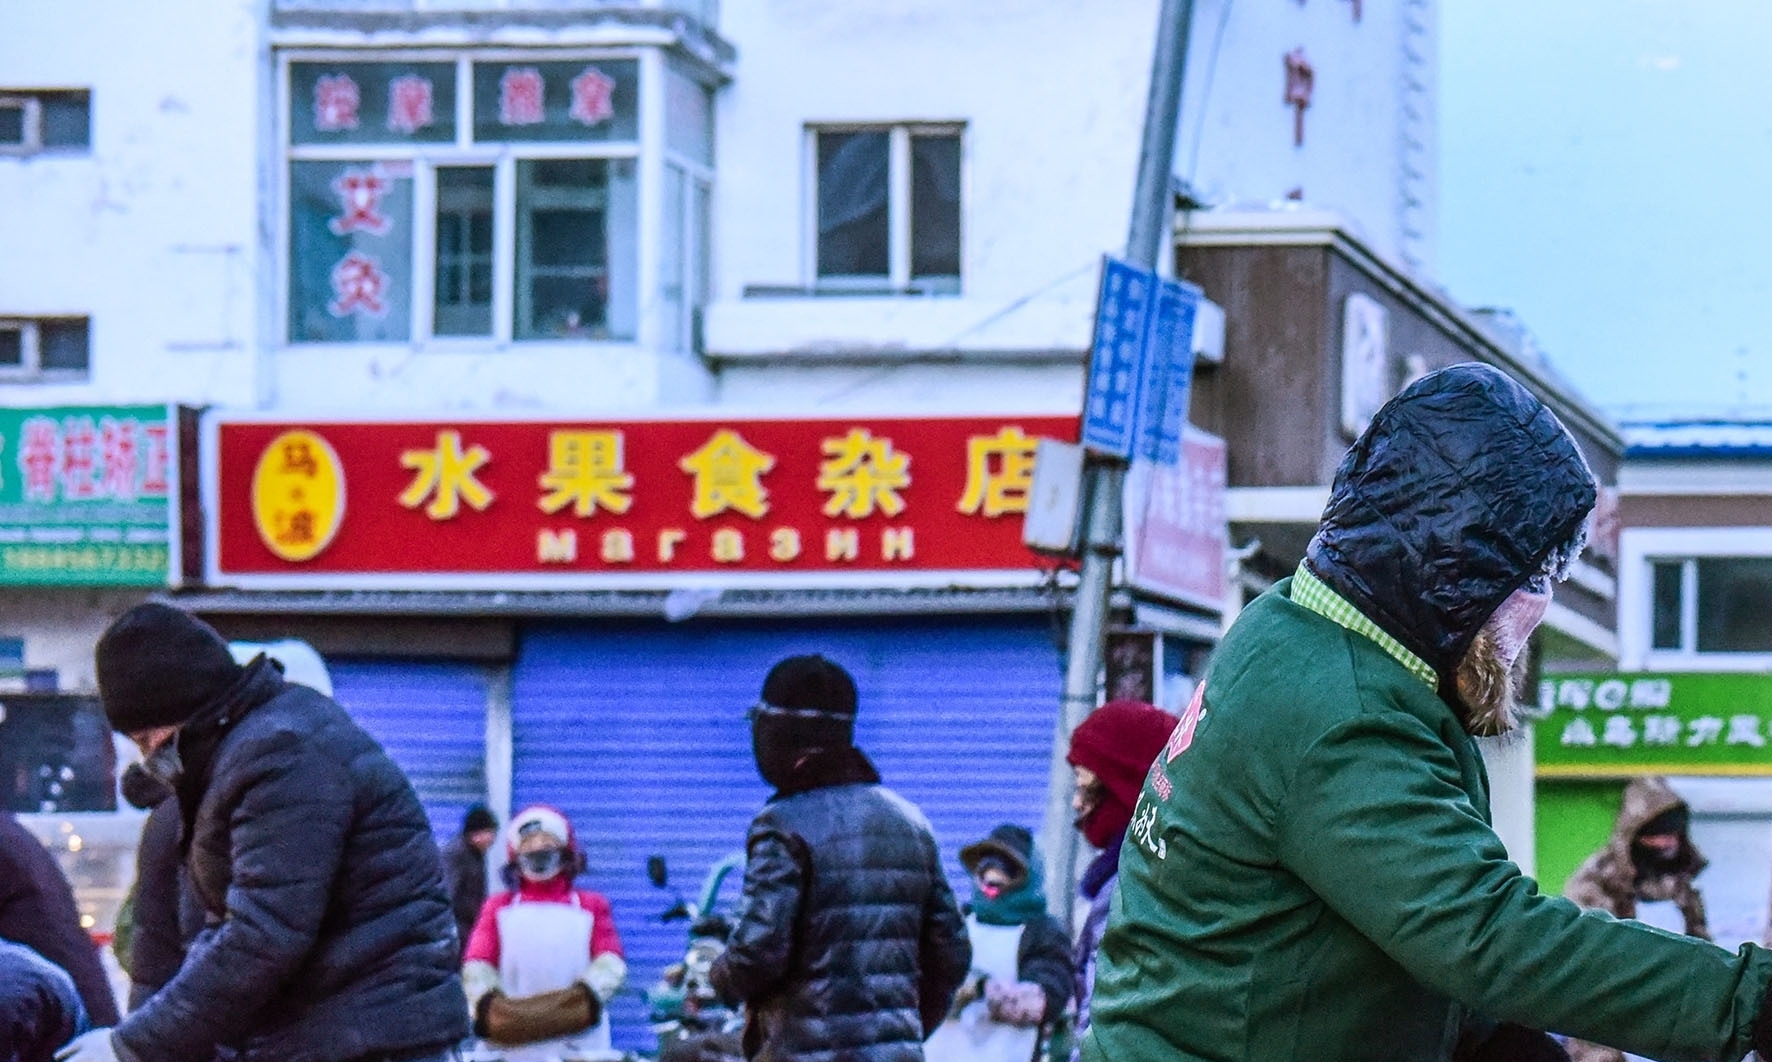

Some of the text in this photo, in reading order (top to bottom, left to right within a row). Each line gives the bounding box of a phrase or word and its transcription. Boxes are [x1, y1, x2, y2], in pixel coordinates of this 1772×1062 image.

[401, 427, 1038, 521] 水果食杂店
